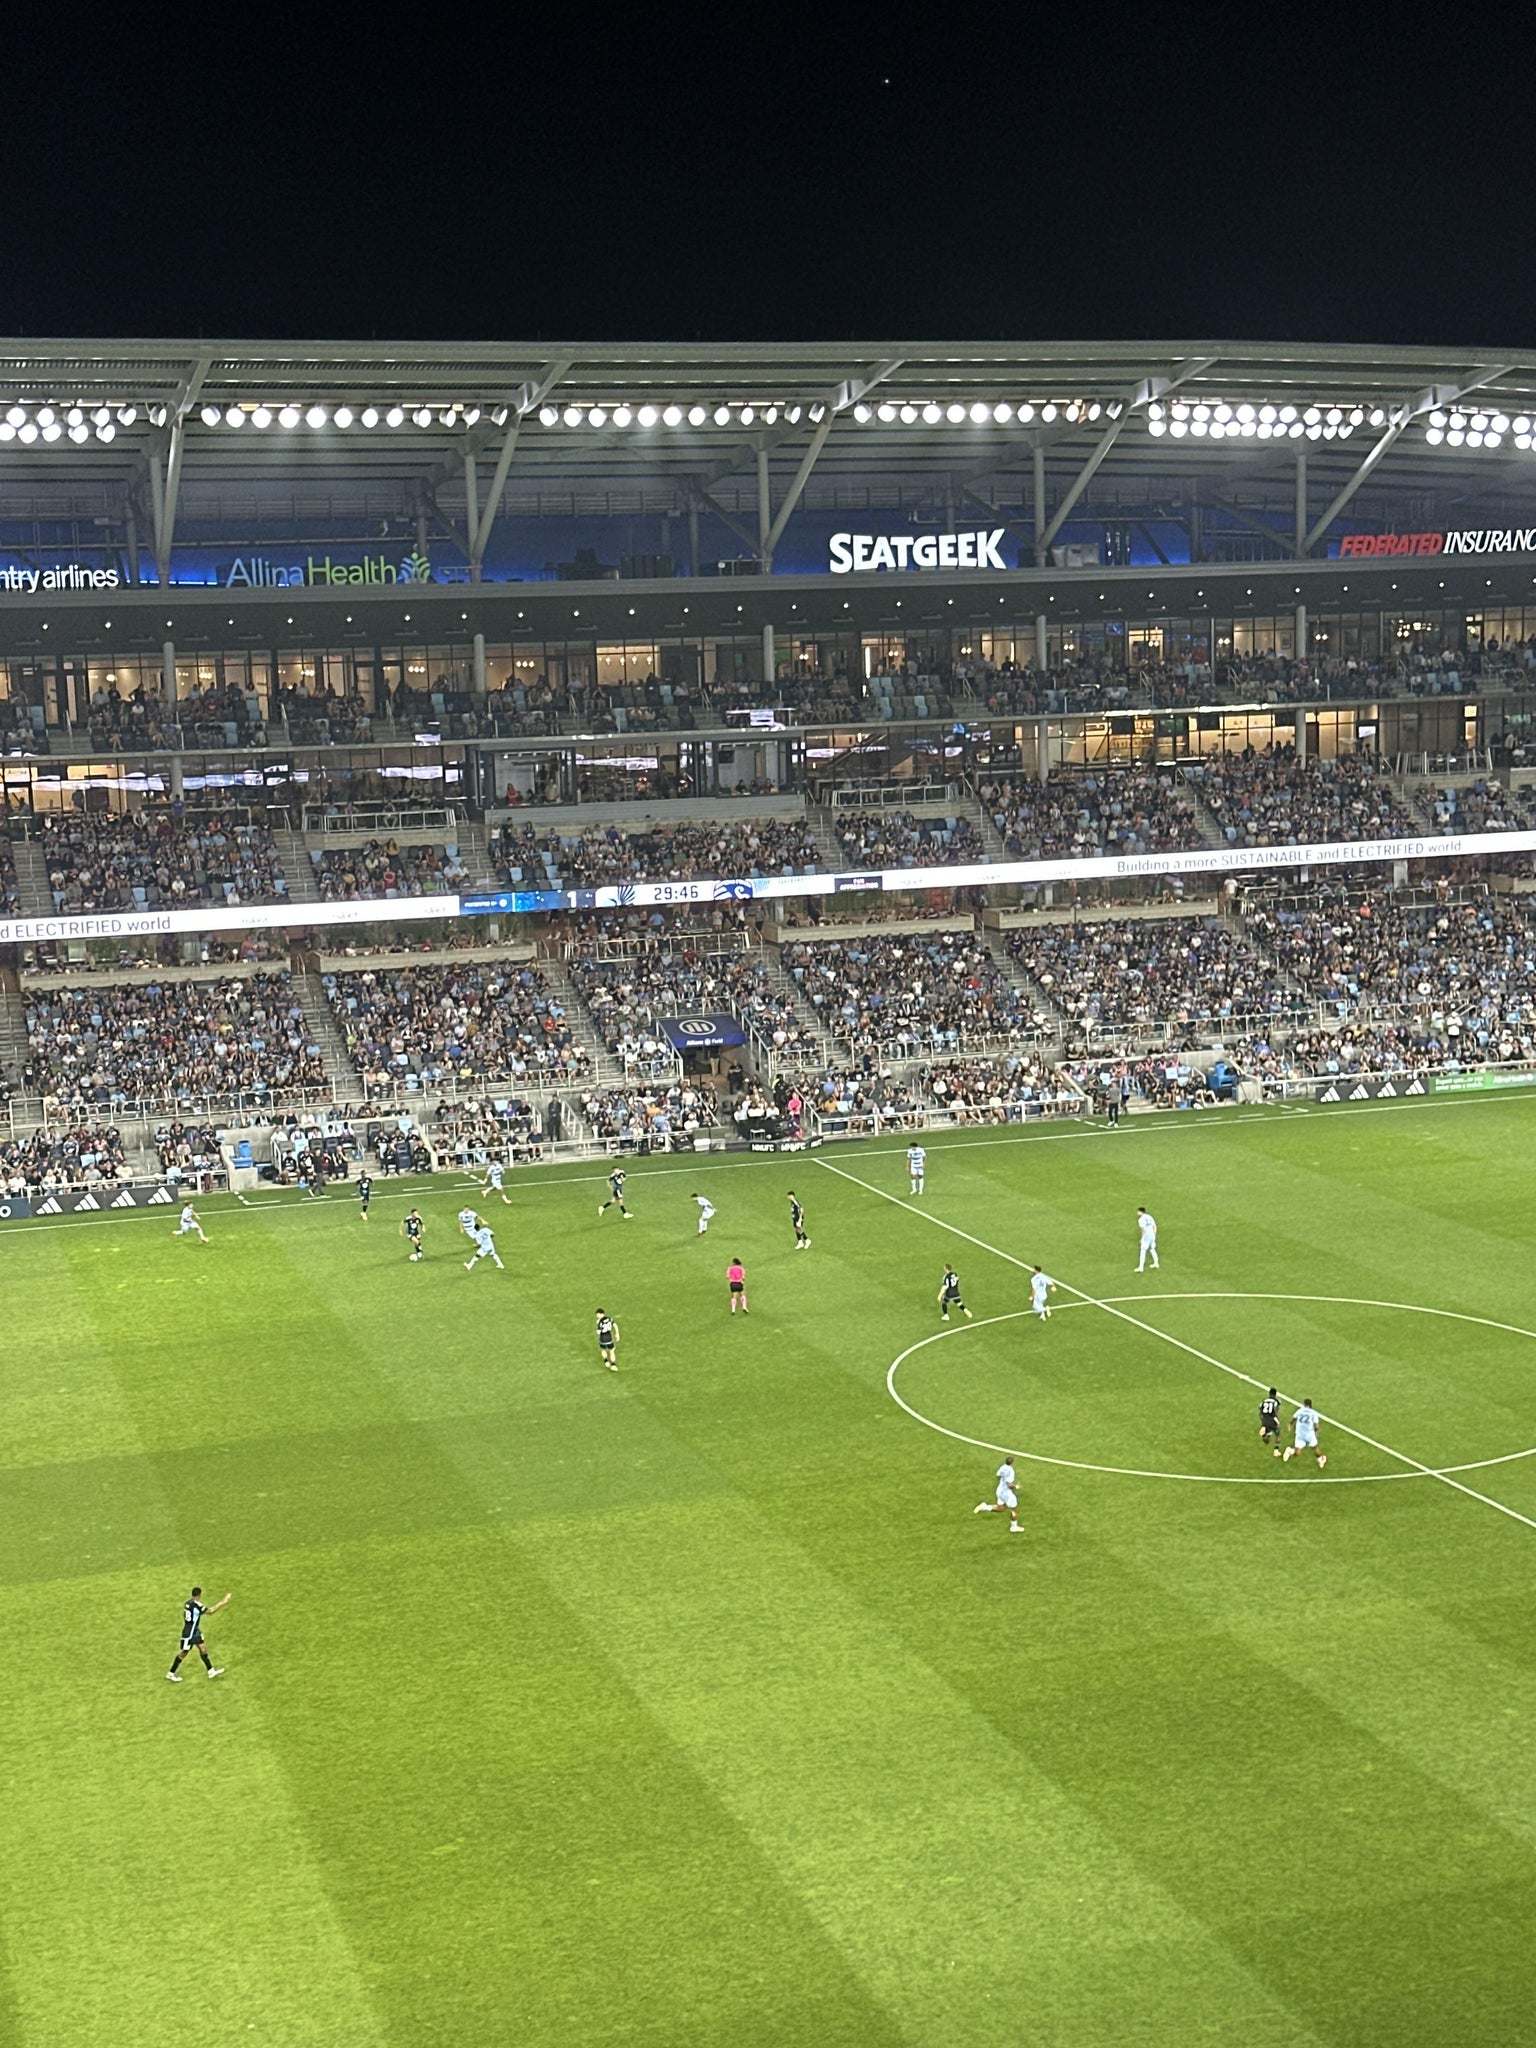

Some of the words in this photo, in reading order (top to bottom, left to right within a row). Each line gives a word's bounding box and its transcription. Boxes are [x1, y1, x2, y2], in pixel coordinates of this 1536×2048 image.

[829, 528, 1006, 573] SEATGEEK
[1339, 533, 1443, 557] FEDERATED
[42, 564, 119, 589] airlines
[226, 557, 304, 588] Allina
[307, 555, 396, 586] Health
[1117, 860, 1169, 873] Building
[1173, 860, 1180, 869] a
[1184, 858, 1217, 869] more
[1221, 849, 1311, 867] SUSTAINABLE
[1317, 847, 1339, 860] and
[1343, 843, 1424, 859] ELECTRIFIED
[1428, 841, 1461, 853] world
[567, 891, 576, 908] 1
[654, 885, 699, 901] 29:46
[15, 919, 122, 938] ELECTRIFIED
[127, 916, 171, 931] world
[1263, 1403, 1273, 1414] 21
